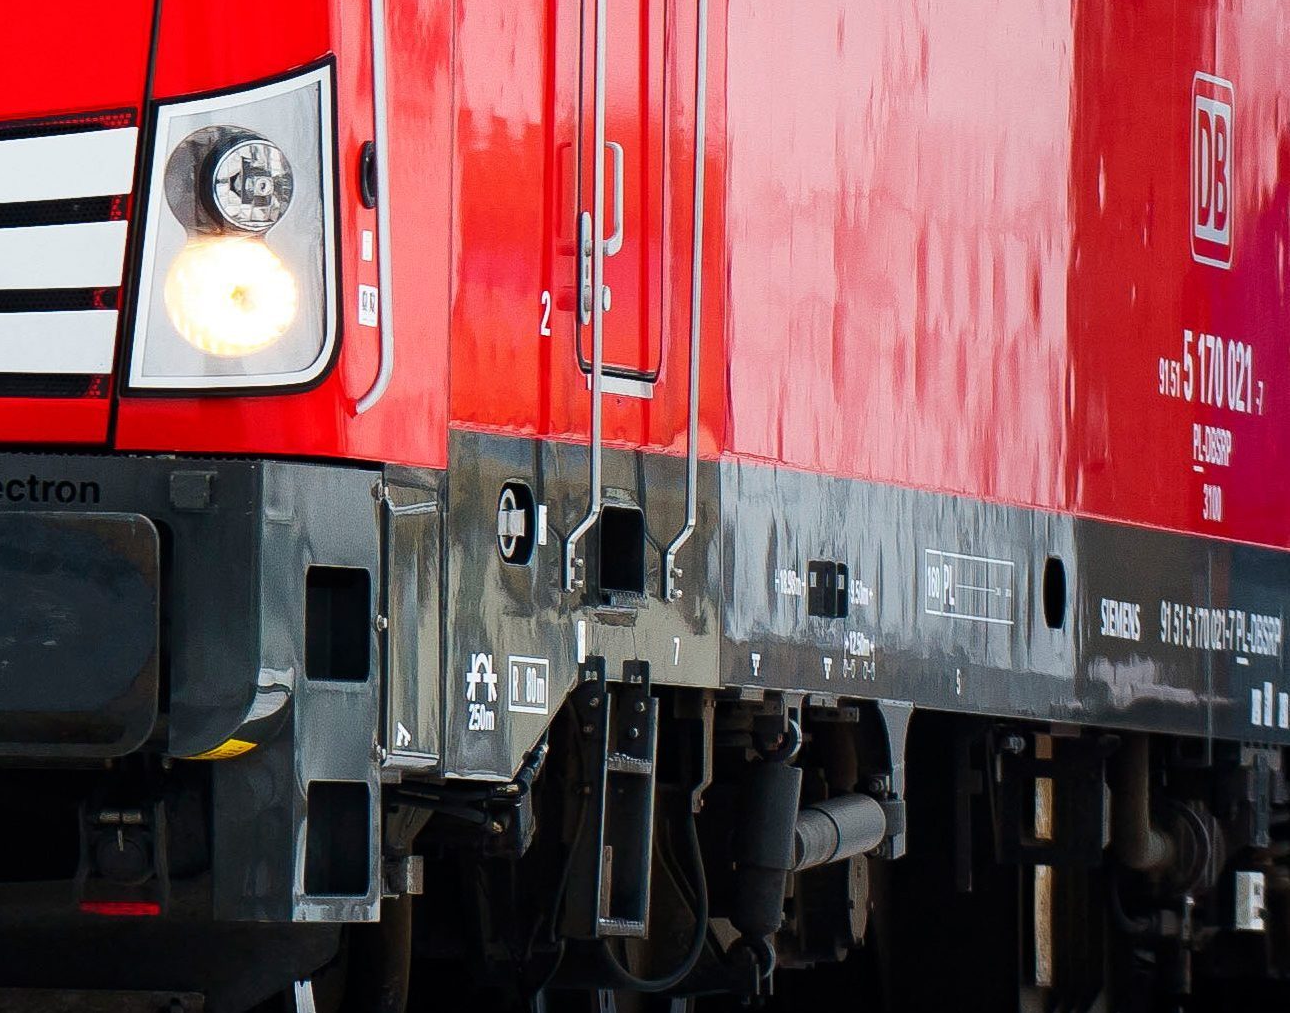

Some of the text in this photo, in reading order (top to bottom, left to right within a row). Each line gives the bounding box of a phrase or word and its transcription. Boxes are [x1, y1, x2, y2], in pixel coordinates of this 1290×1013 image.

[540, 290, 552, 337] 2
[1158, 357, 1169, 396] 91
[1170, 359, 1181, 398] 51
[1183, 328, 1194, 403] 5
[1198, 333, 1224, 409] 170
[1227, 339, 1253, 414] 021
[943, 563, 956, 607] PL
[1101, 598, 1141, 641] SIEMENS
[511, 665, 520, 703] R
[468, 703, 495, 731] 250m
